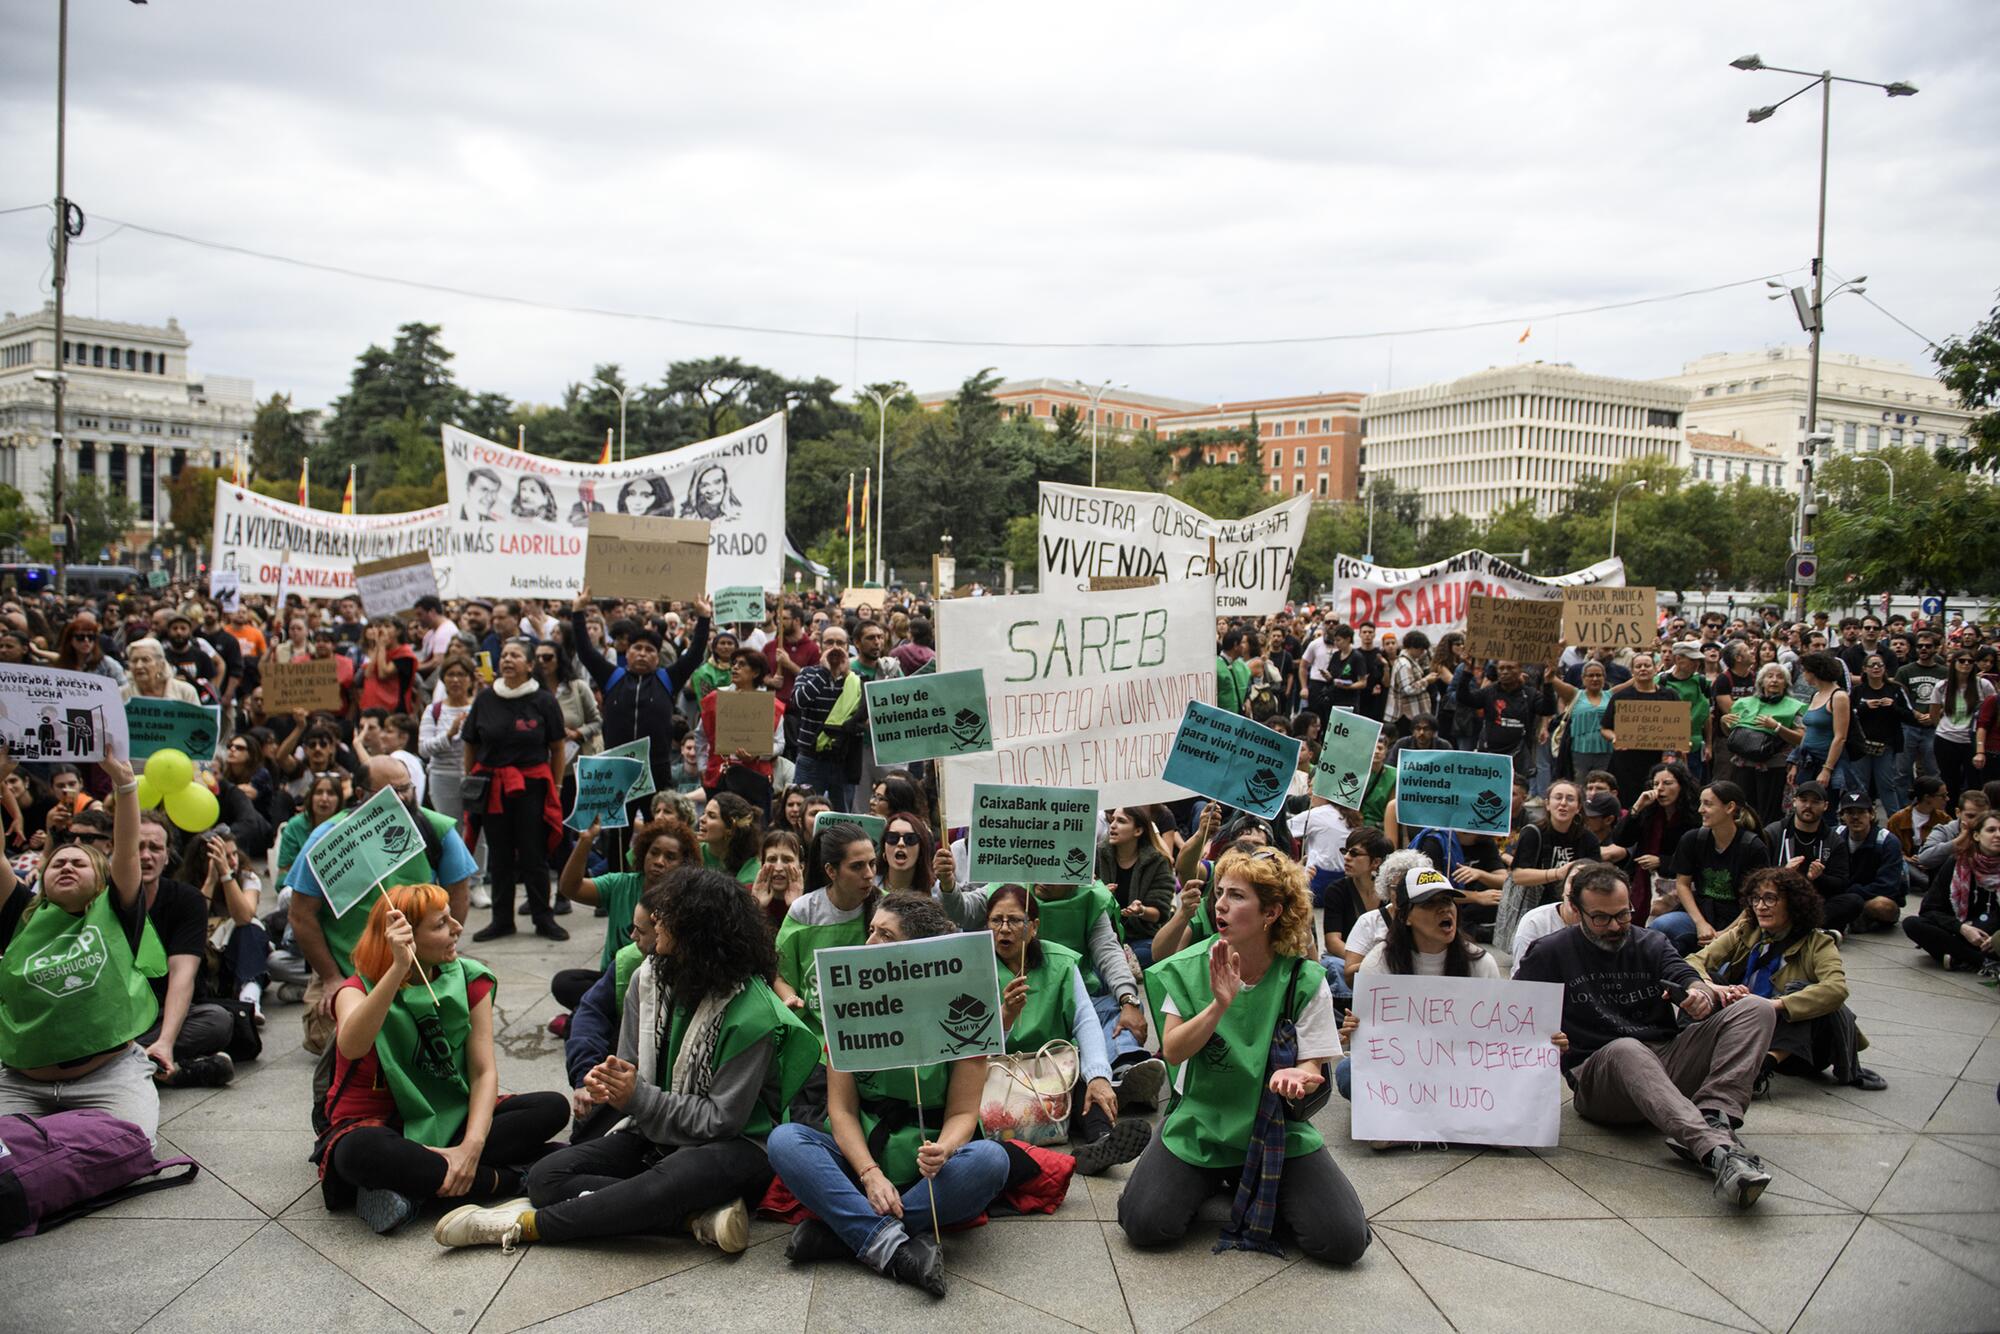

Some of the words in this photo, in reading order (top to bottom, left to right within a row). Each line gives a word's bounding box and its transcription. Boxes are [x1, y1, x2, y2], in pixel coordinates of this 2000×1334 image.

[1041, 493, 1136, 533] NUESTRA
[1153, 505, 1210, 540] CLASE
[222, 513, 242, 547] LA
[247, 515, 311, 552] VIVIENDA
[314, 527, 349, 557] PARA
[418, 525, 450, 557] HABI
[463, 526, 495, 554] MÁS
[499, 533, 581, 556] LADRILLO
[1043, 535, 1169, 583] VIVIENDA
[1338, 558, 1372, 580] HOY
[510, 575, 562, 590] Asamblea
[565, 576, 579, 589] de
[1215, 595, 1248, 608] ETUAN
[1564, 589, 1607, 601] VIVIENDA
[1470, 597, 1484, 609] EL
[1492, 598, 1559, 618] DOMINGO
[1473, 612, 1487, 624] SE
[1577, 603, 1645, 616] TRAFICANTES
[1575, 621, 1643, 645] VIDAS
[1004, 608, 1168, 683] SAREB
[27, 690, 63, 699] LUCHA
[56, 680, 103, 692] NUESTRA
[872, 695, 888, 708] La
[891, 693, 910, 706] ley
[913, 689, 929, 701] de
[988, 695, 1000, 741] L
[1005, 687, 1094, 739] DERECHO
[1099, 683, 1115, 728] A
[1117, 678, 1161, 726] UNA
[1157, 671, 1217, 721] VIVIEND
[1616, 703, 1662, 714] MUCHO
[874, 708, 928, 725] vivienda
[931, 706, 947, 716] es
[877, 731, 901, 743] una
[904, 722, 949, 739] mierda
[1187, 709, 1209, 725] Por
[1209, 718, 1232, 734] una
[1234, 725, 1281, 752] vivienda
[1334, 722, 1350, 738] de
[1637, 724, 1665, 734] PERO
[1176, 740, 1220, 765] invertir
[1181, 726, 1209, 743] para
[1210, 735, 1238, 755] vivir,
[1239, 747, 1256, 759] no
[1255, 754, 1284, 771] para
[581, 768, 593, 780] La
[997, 743, 1073, 787] DIGNA
[1080, 740, 1108, 786] EN
[1403, 761, 1441, 775] ¡Abajo
[1443, 763, 1455, 774] el
[1457, 764, 1503, 780] trabajo,
[1401, 775, 1452, 790] vivienda
[979, 795, 1047, 811] CaixaBank
[1050, 799, 1091, 815] quiere
[1401, 791, 1460, 806] universal!
[978, 815, 1050, 831] desahuciar
[1052, 821, 1060, 832] a
[1062, 817, 1084, 832] Pili
[312, 847, 327, 865] Por
[327, 833, 344, 851] una
[344, 805, 385, 837] vivienda
[318, 859, 338, 879] para
[337, 838, 360, 859] vivir,
[359, 830, 374, 842] no
[373, 813, 397, 836] para
[977, 835, 1007, 849] este
[1009, 835, 1056, 850] viernes
[977, 853, 1061, 869] #PilarSeQueda
[325, 857, 356, 889] invertir
[33, 931, 95, 970] STOP
[33, 951, 103, 984] DESAHUCIOS
[829, 964, 852, 988] El
[857, 956, 964, 991] gobierno
[1599, 983, 1661, 1005] ANGELES
[832, 993, 905, 1020] vende
[1368, 986, 1459, 1028] TENER
[1470, 1000, 1536, 1036] CASA
[837, 1029, 905, 1051] humo
[953, 1024, 969, 1034] PAH
[1368, 1037, 1406, 1067] ES
[1416, 1038, 1457, 1067] UN
[1467, 1040, 1560, 1072] DERECHO
[1366, 1080, 1399, 1107] NO
[1408, 1081, 1438, 1105] UN
[1449, 1085, 1495, 1112] LUJO
